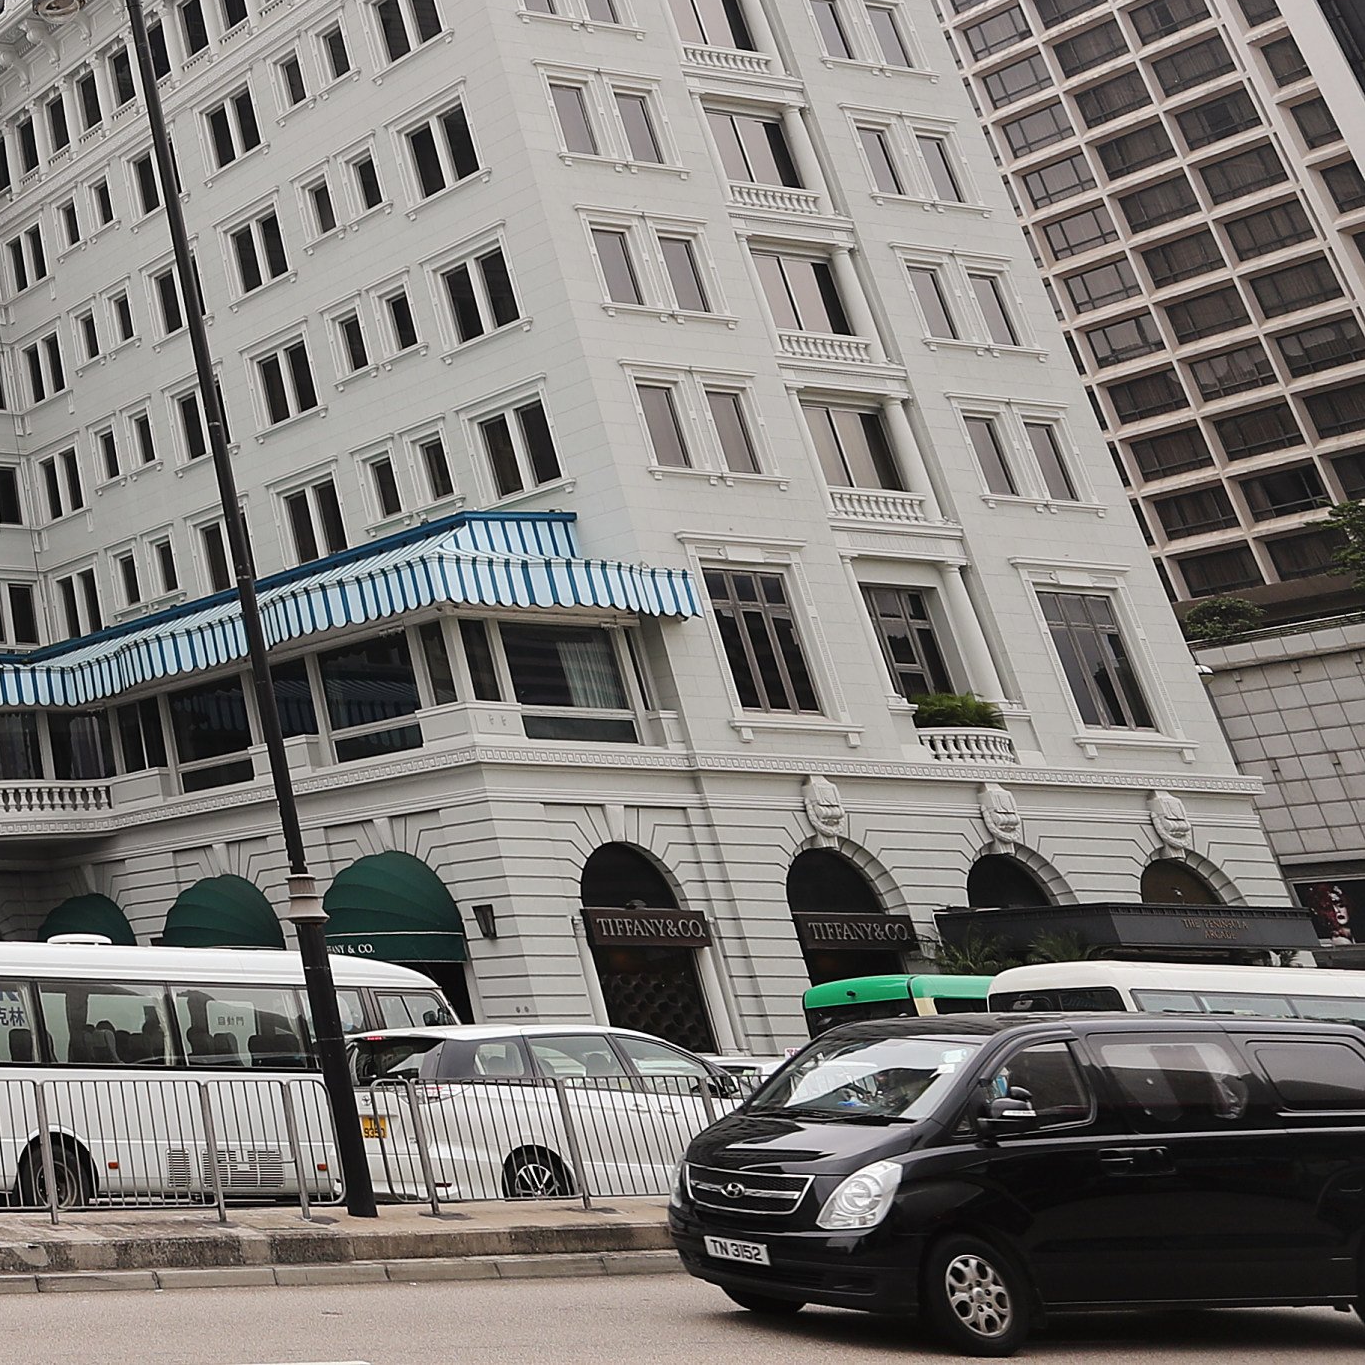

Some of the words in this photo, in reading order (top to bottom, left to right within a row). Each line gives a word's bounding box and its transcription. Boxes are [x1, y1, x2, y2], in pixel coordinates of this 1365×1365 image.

[1182, 918, 1201, 928] THE
[1203, 918, 1249, 929] PENINSULA
[358, 943, 376, 954] CO.
[710, 1239, 729, 1255] TN
[730, 1242, 763, 1262] 3152
